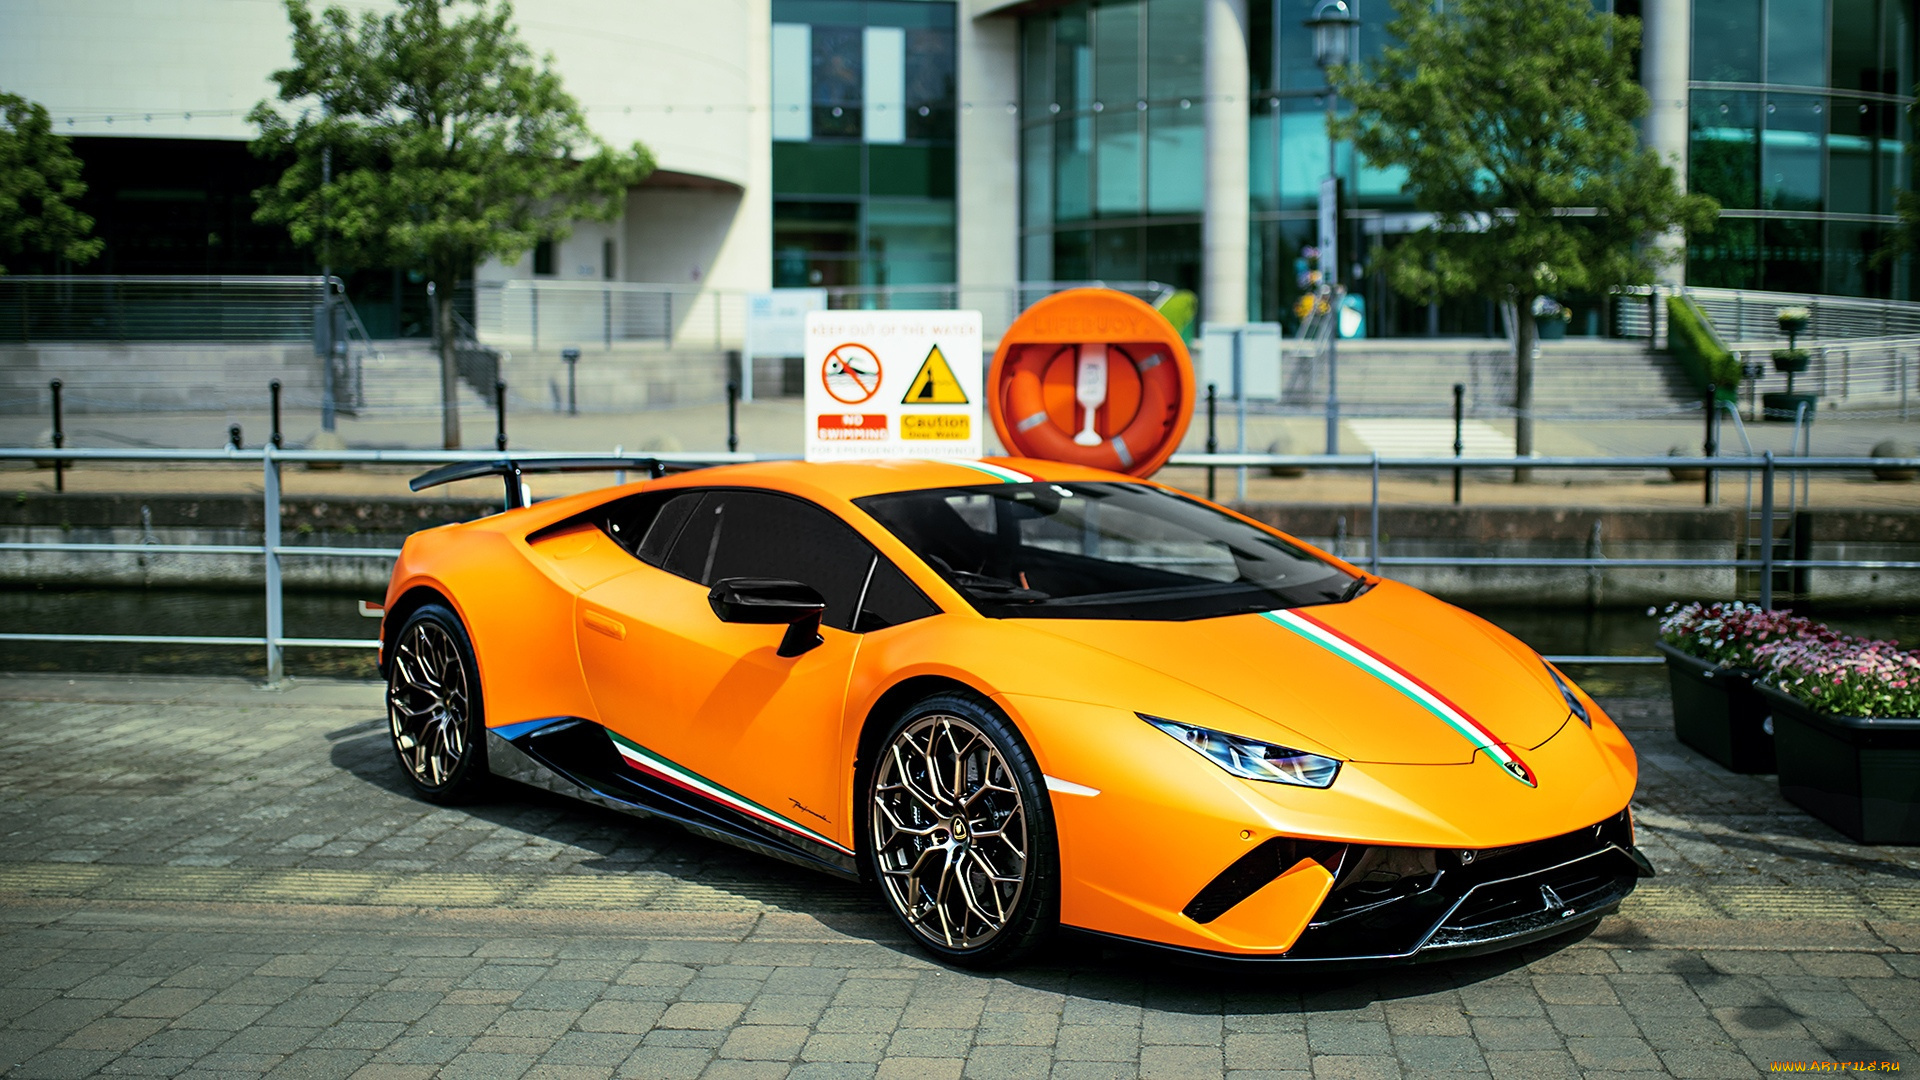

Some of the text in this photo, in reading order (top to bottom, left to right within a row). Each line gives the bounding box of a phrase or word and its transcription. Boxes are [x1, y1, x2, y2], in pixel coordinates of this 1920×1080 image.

[932, 324, 977, 336] WATER
[842, 414, 863, 426] NO
[904, 415, 969, 428] Caution
[819, 428, 888, 440] SWIMMING
